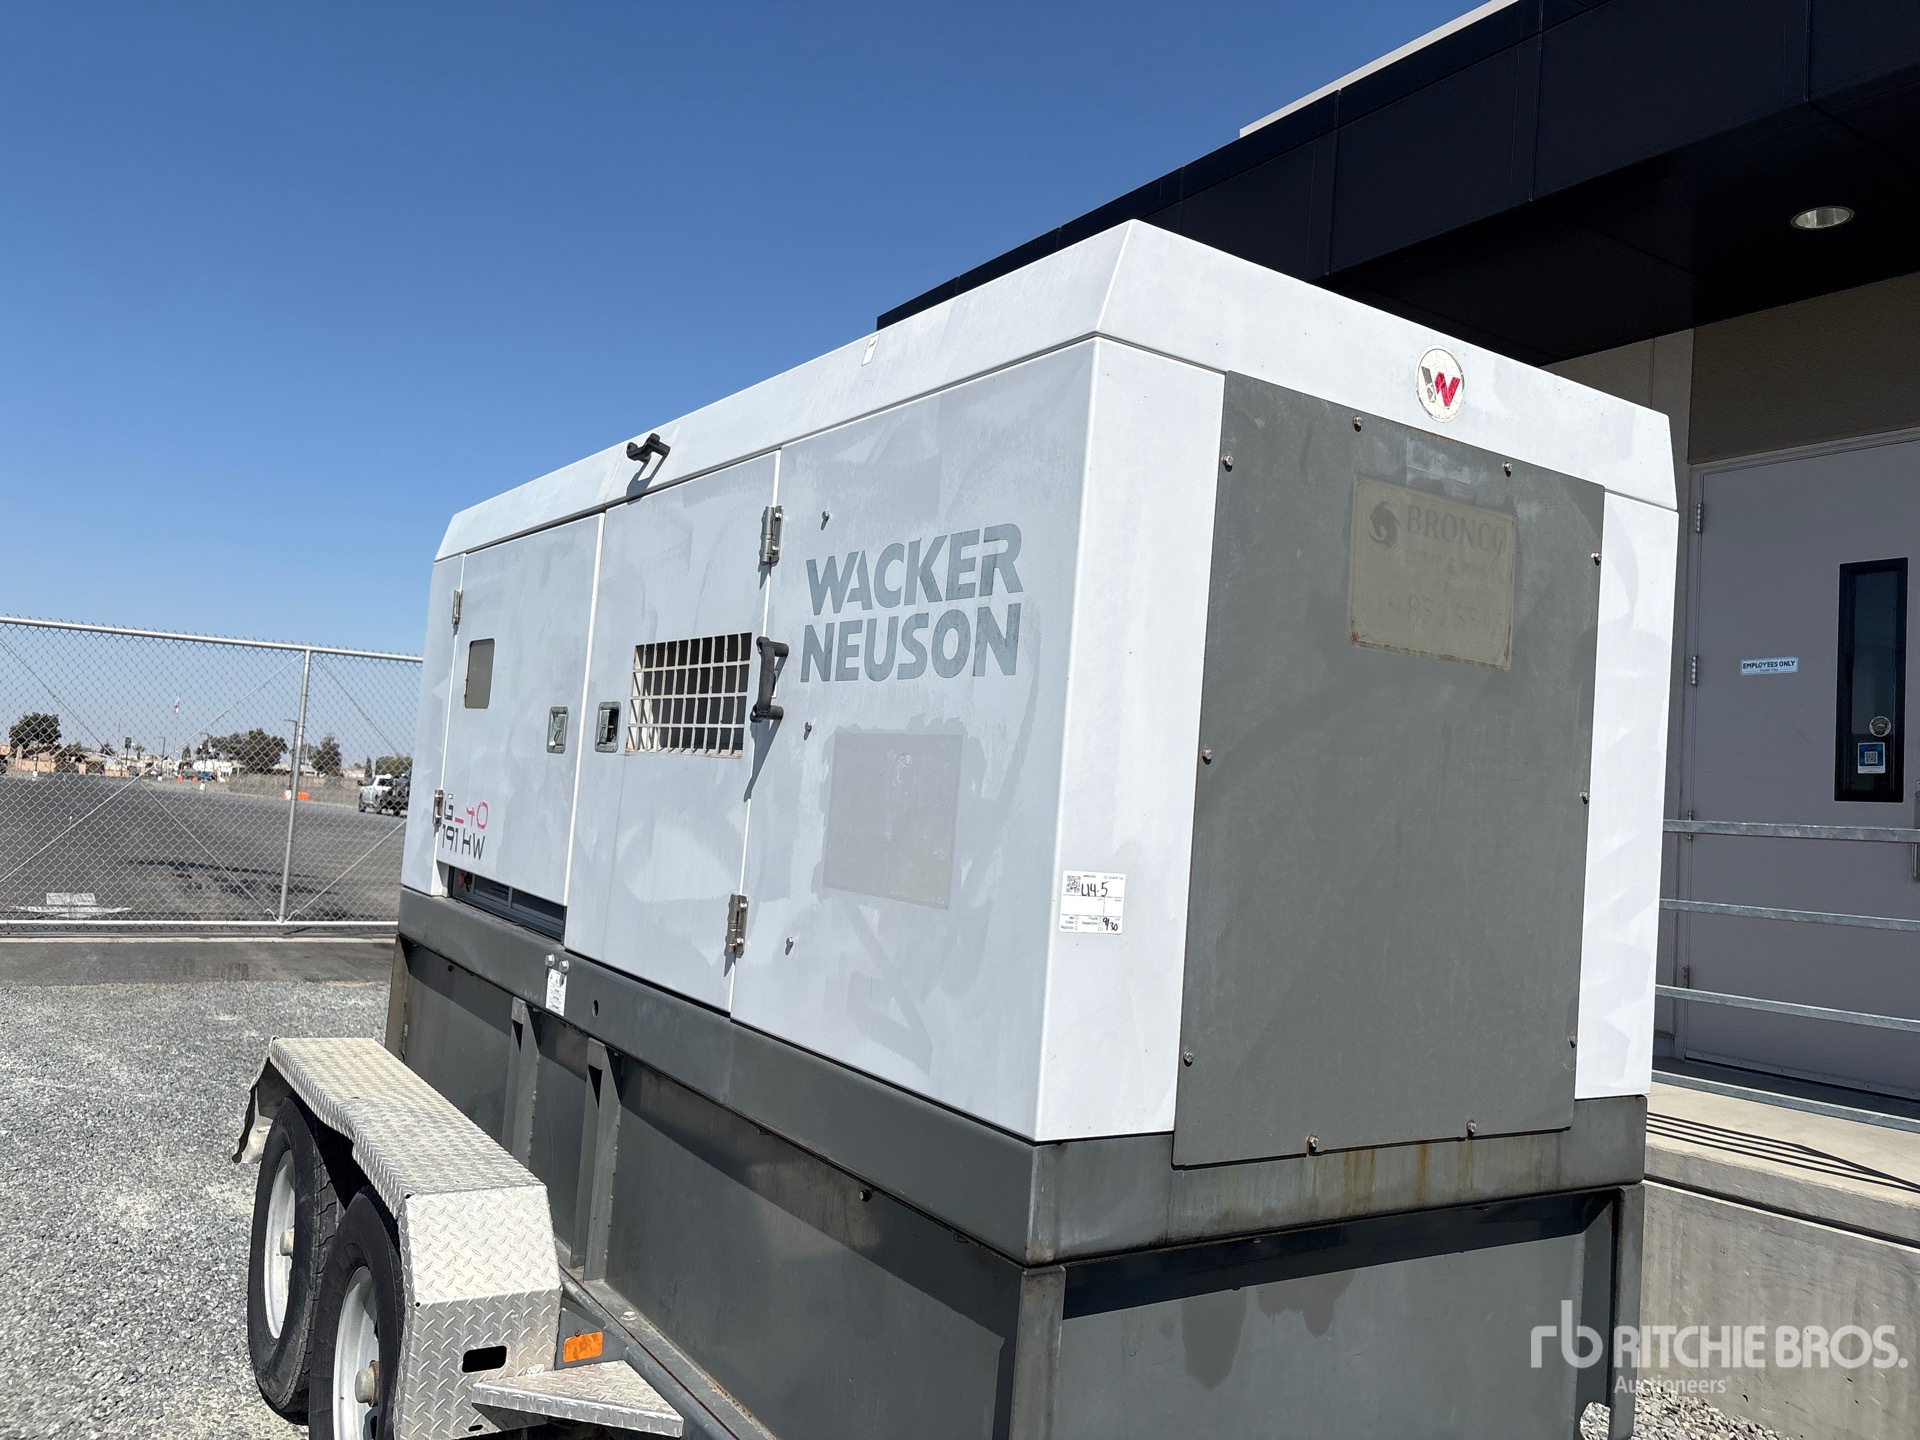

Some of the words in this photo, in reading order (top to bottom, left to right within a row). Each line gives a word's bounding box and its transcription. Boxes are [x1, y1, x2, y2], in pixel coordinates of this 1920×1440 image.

[1406, 503, 1508, 554] BRONCO
[805, 523, 1024, 616] WACKER
[800, 603, 1022, 683] NEUSON
[1743, 661, 1778, 669] EMPLOYEES
[1779, 660, 1795, 668] ONLY
[442, 823, 459, 853] 191
